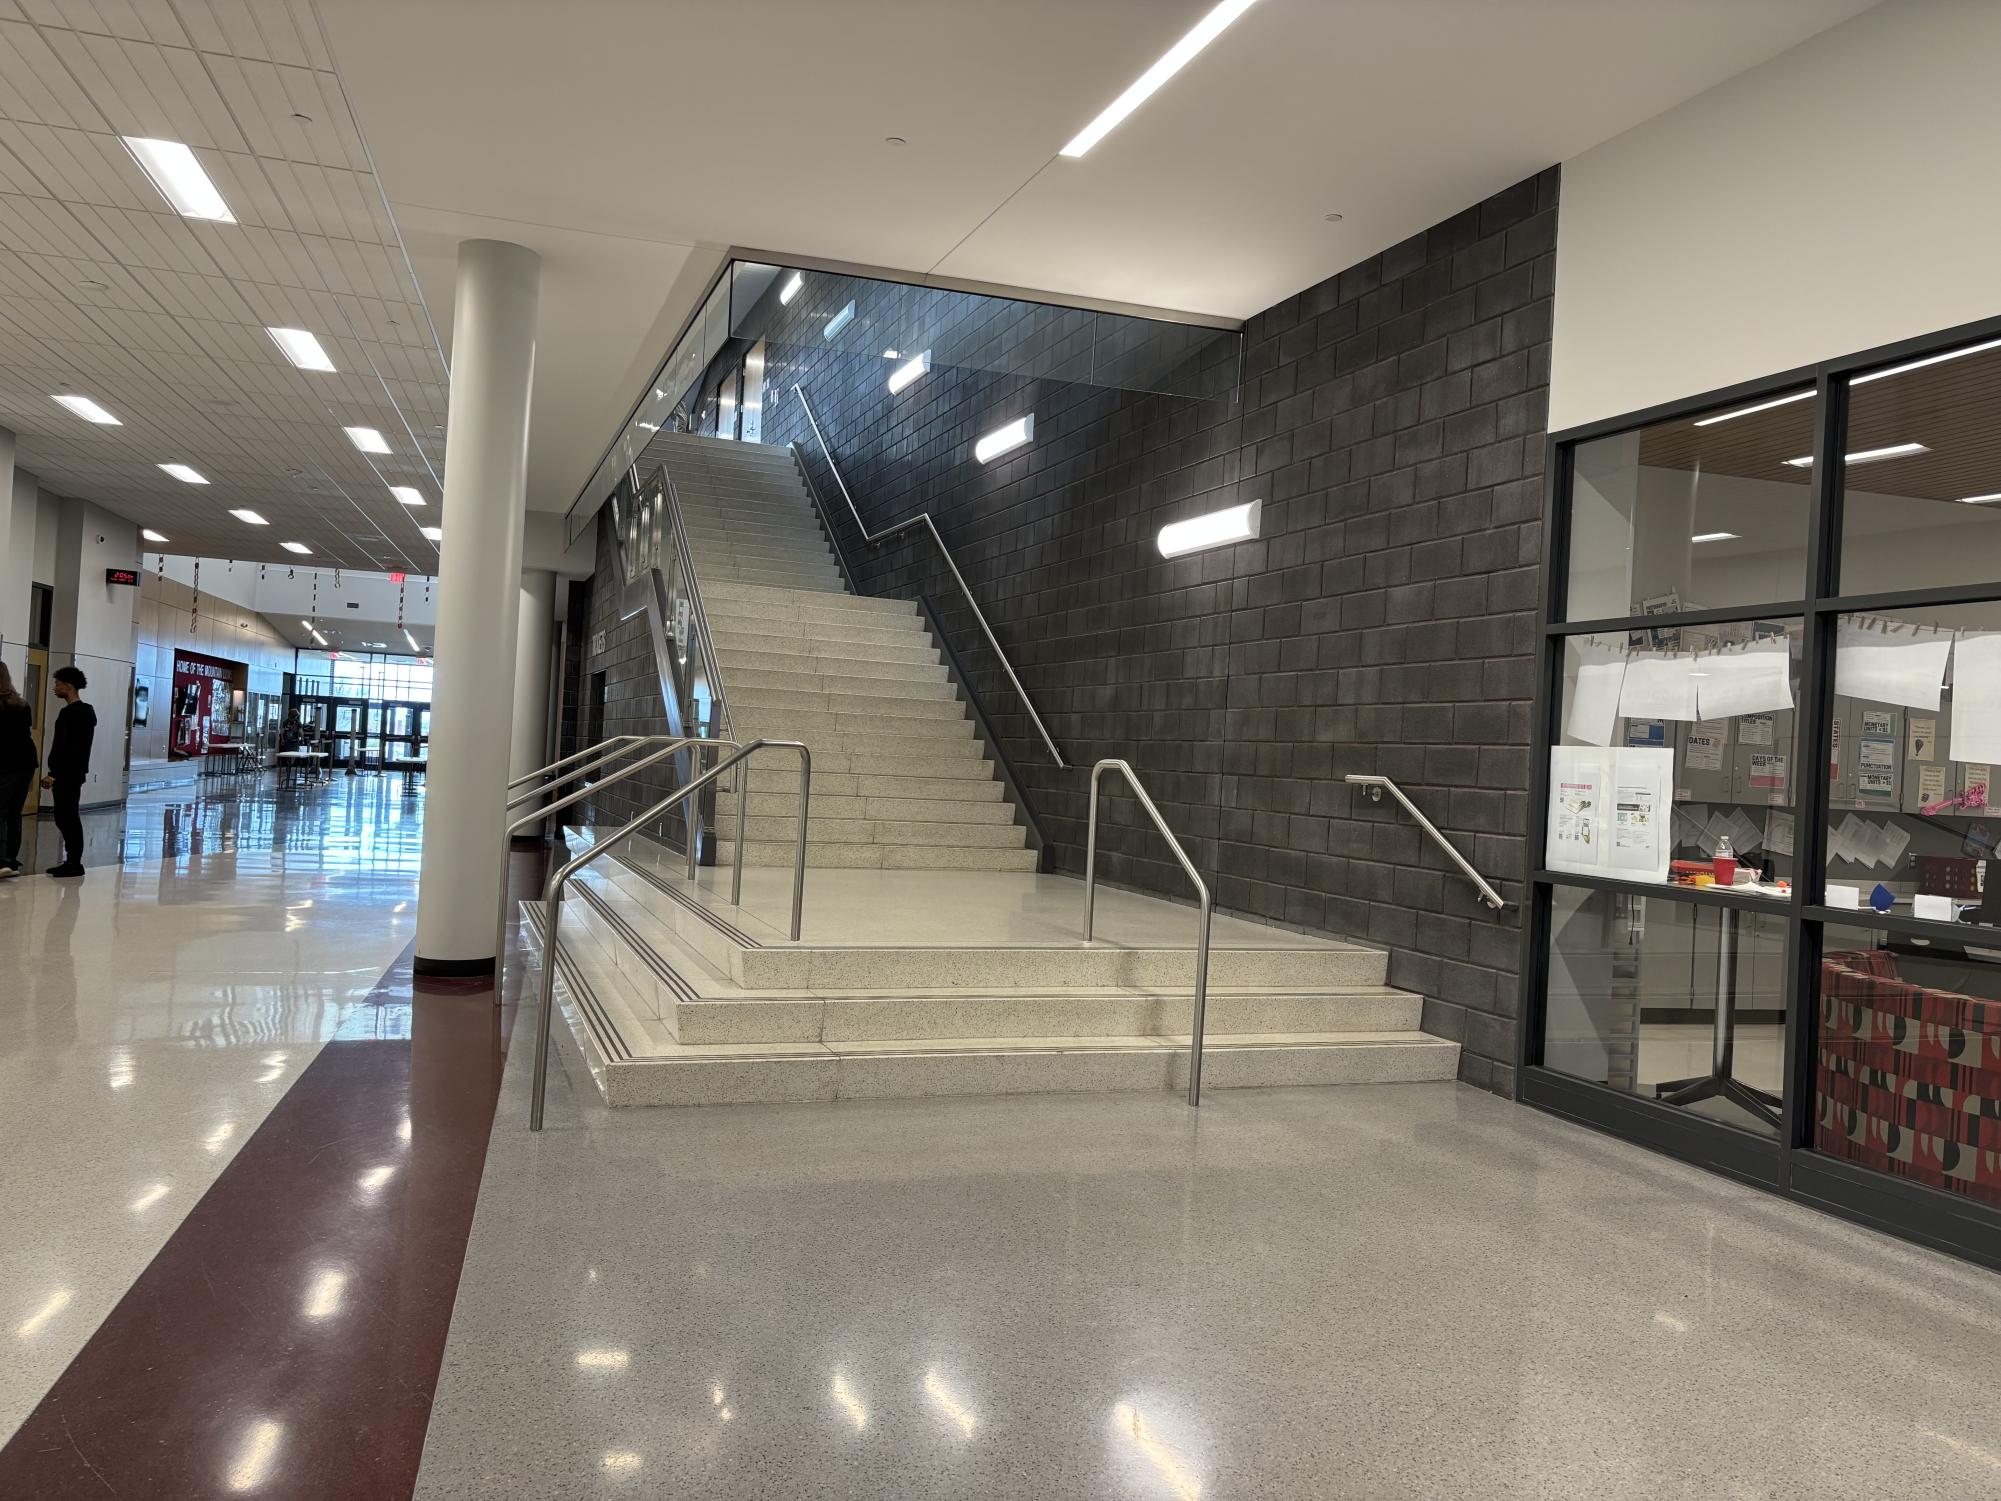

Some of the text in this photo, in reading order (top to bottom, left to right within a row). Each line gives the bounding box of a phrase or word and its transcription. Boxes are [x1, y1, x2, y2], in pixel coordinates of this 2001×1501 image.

[176, 660, 190, 674] HOME
[190, 662, 196, 675] OF
[196, 663, 204, 676] THE
[204, 665, 223, 679] MOUNTAIN
[1689, 736, 1710, 746] DATES
